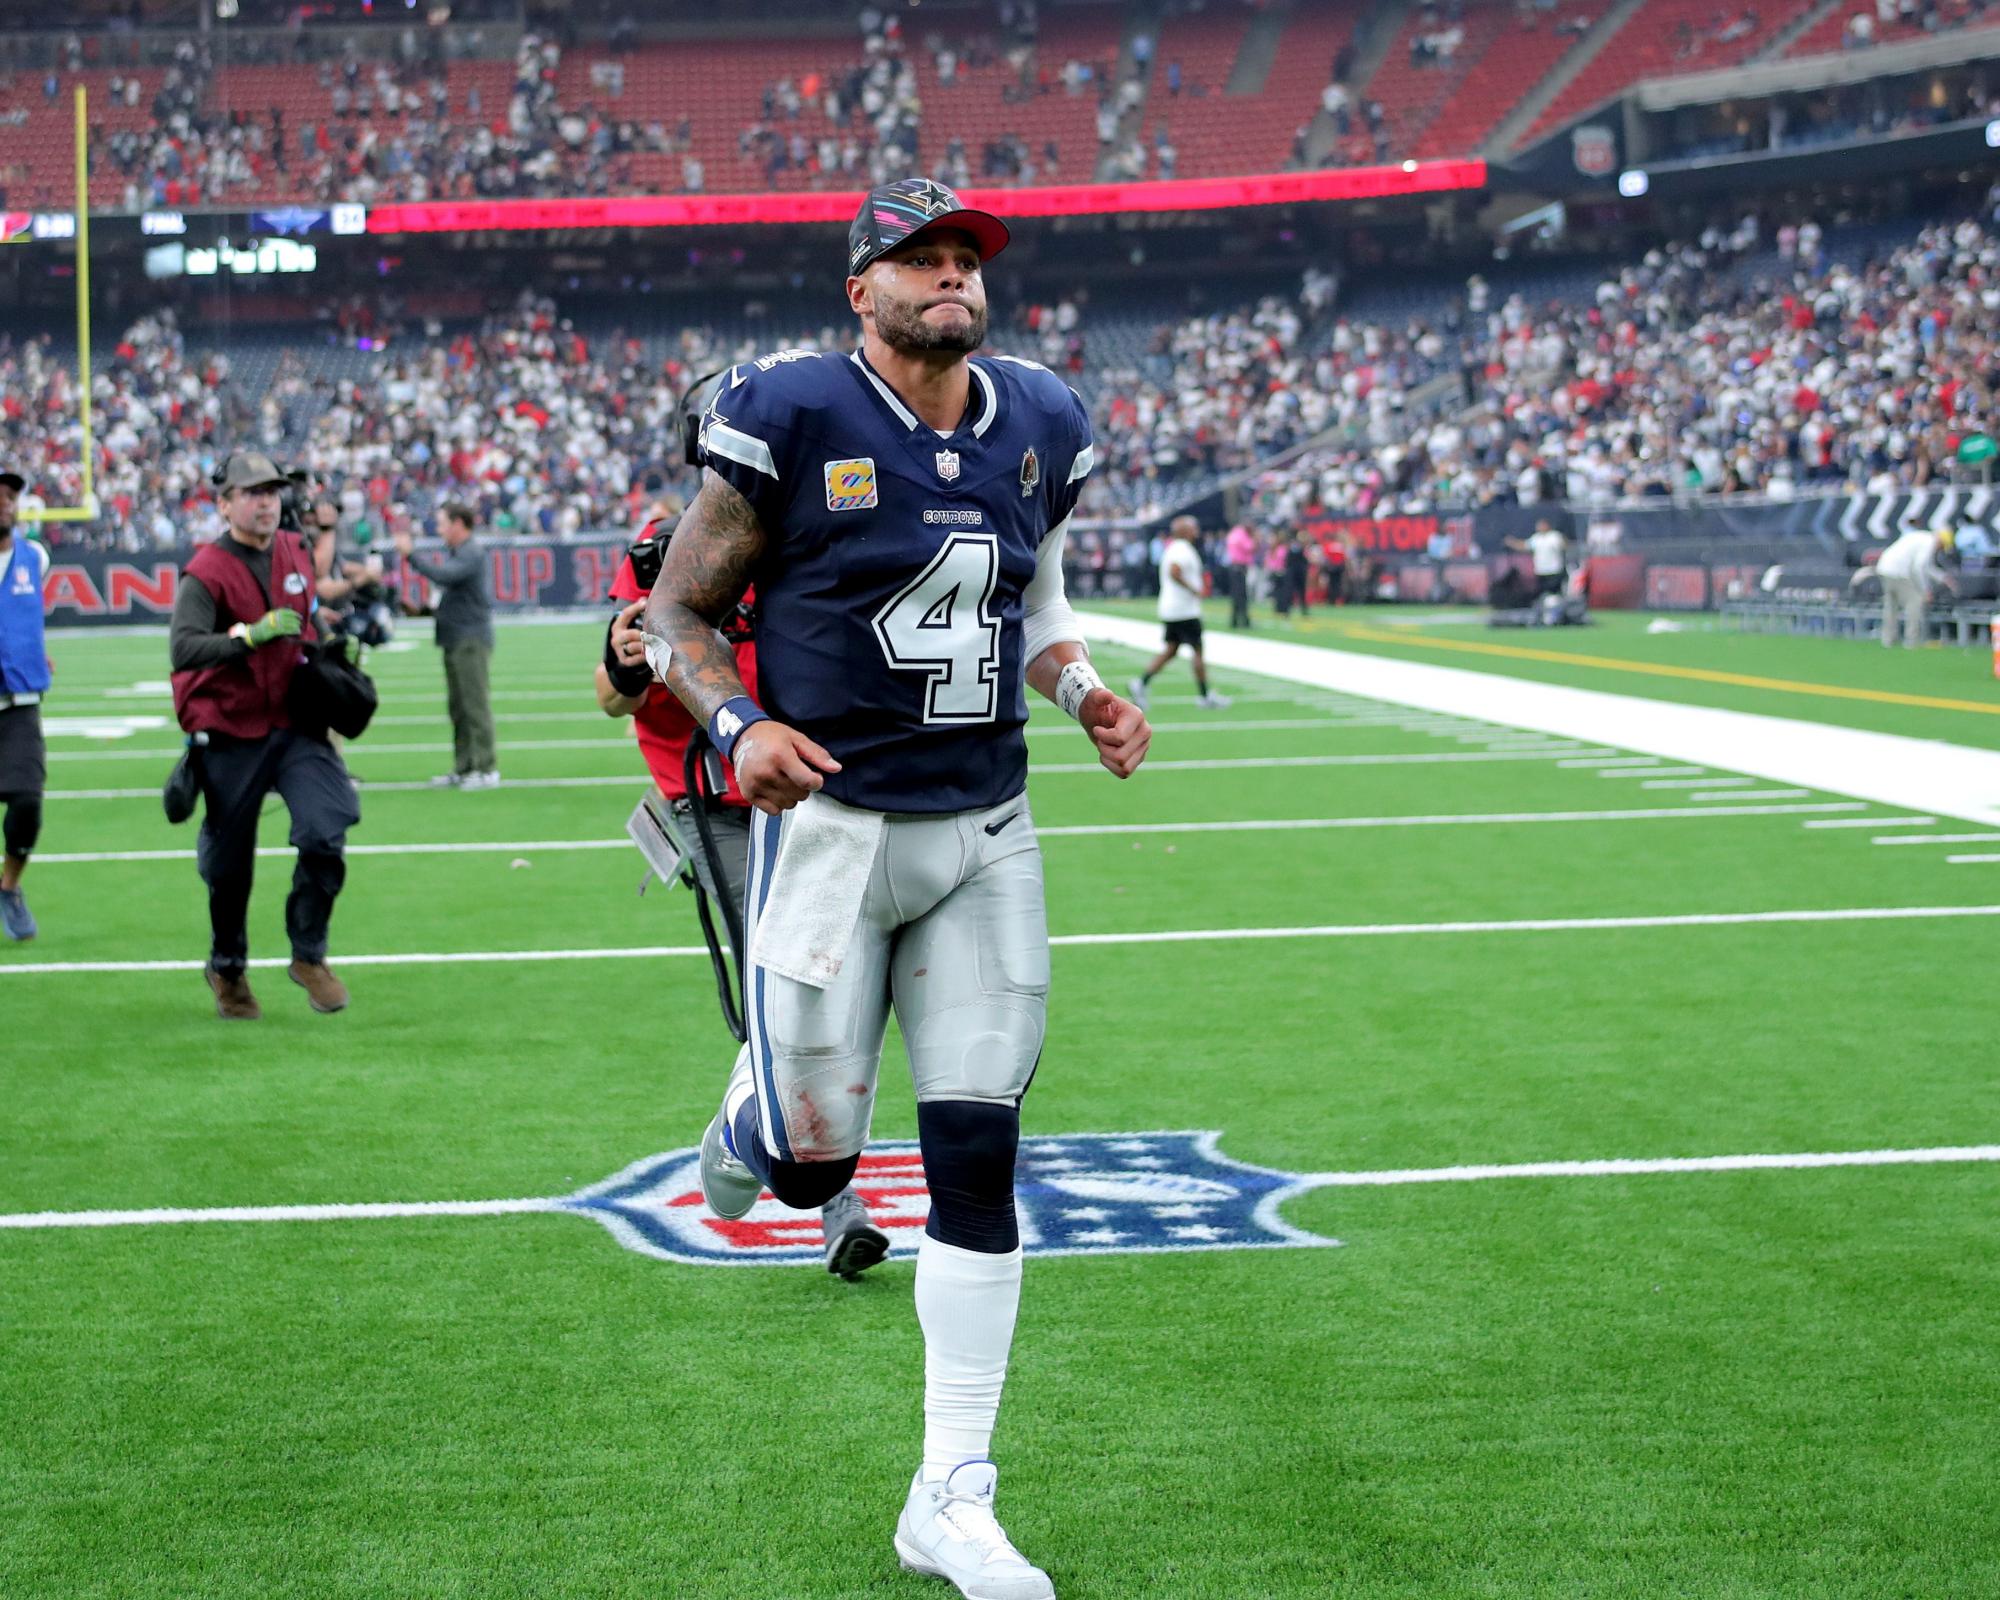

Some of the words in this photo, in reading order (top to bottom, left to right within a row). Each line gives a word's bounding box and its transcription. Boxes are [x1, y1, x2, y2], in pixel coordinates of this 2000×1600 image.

[830, 463, 873, 497] C
[941, 463, 957, 478] NFL
[923, 510, 982, 525] COWBOYS
[491, 543, 556, 604] UP
[871, 531, 1002, 724] 4
[716, 706, 744, 737] 4
